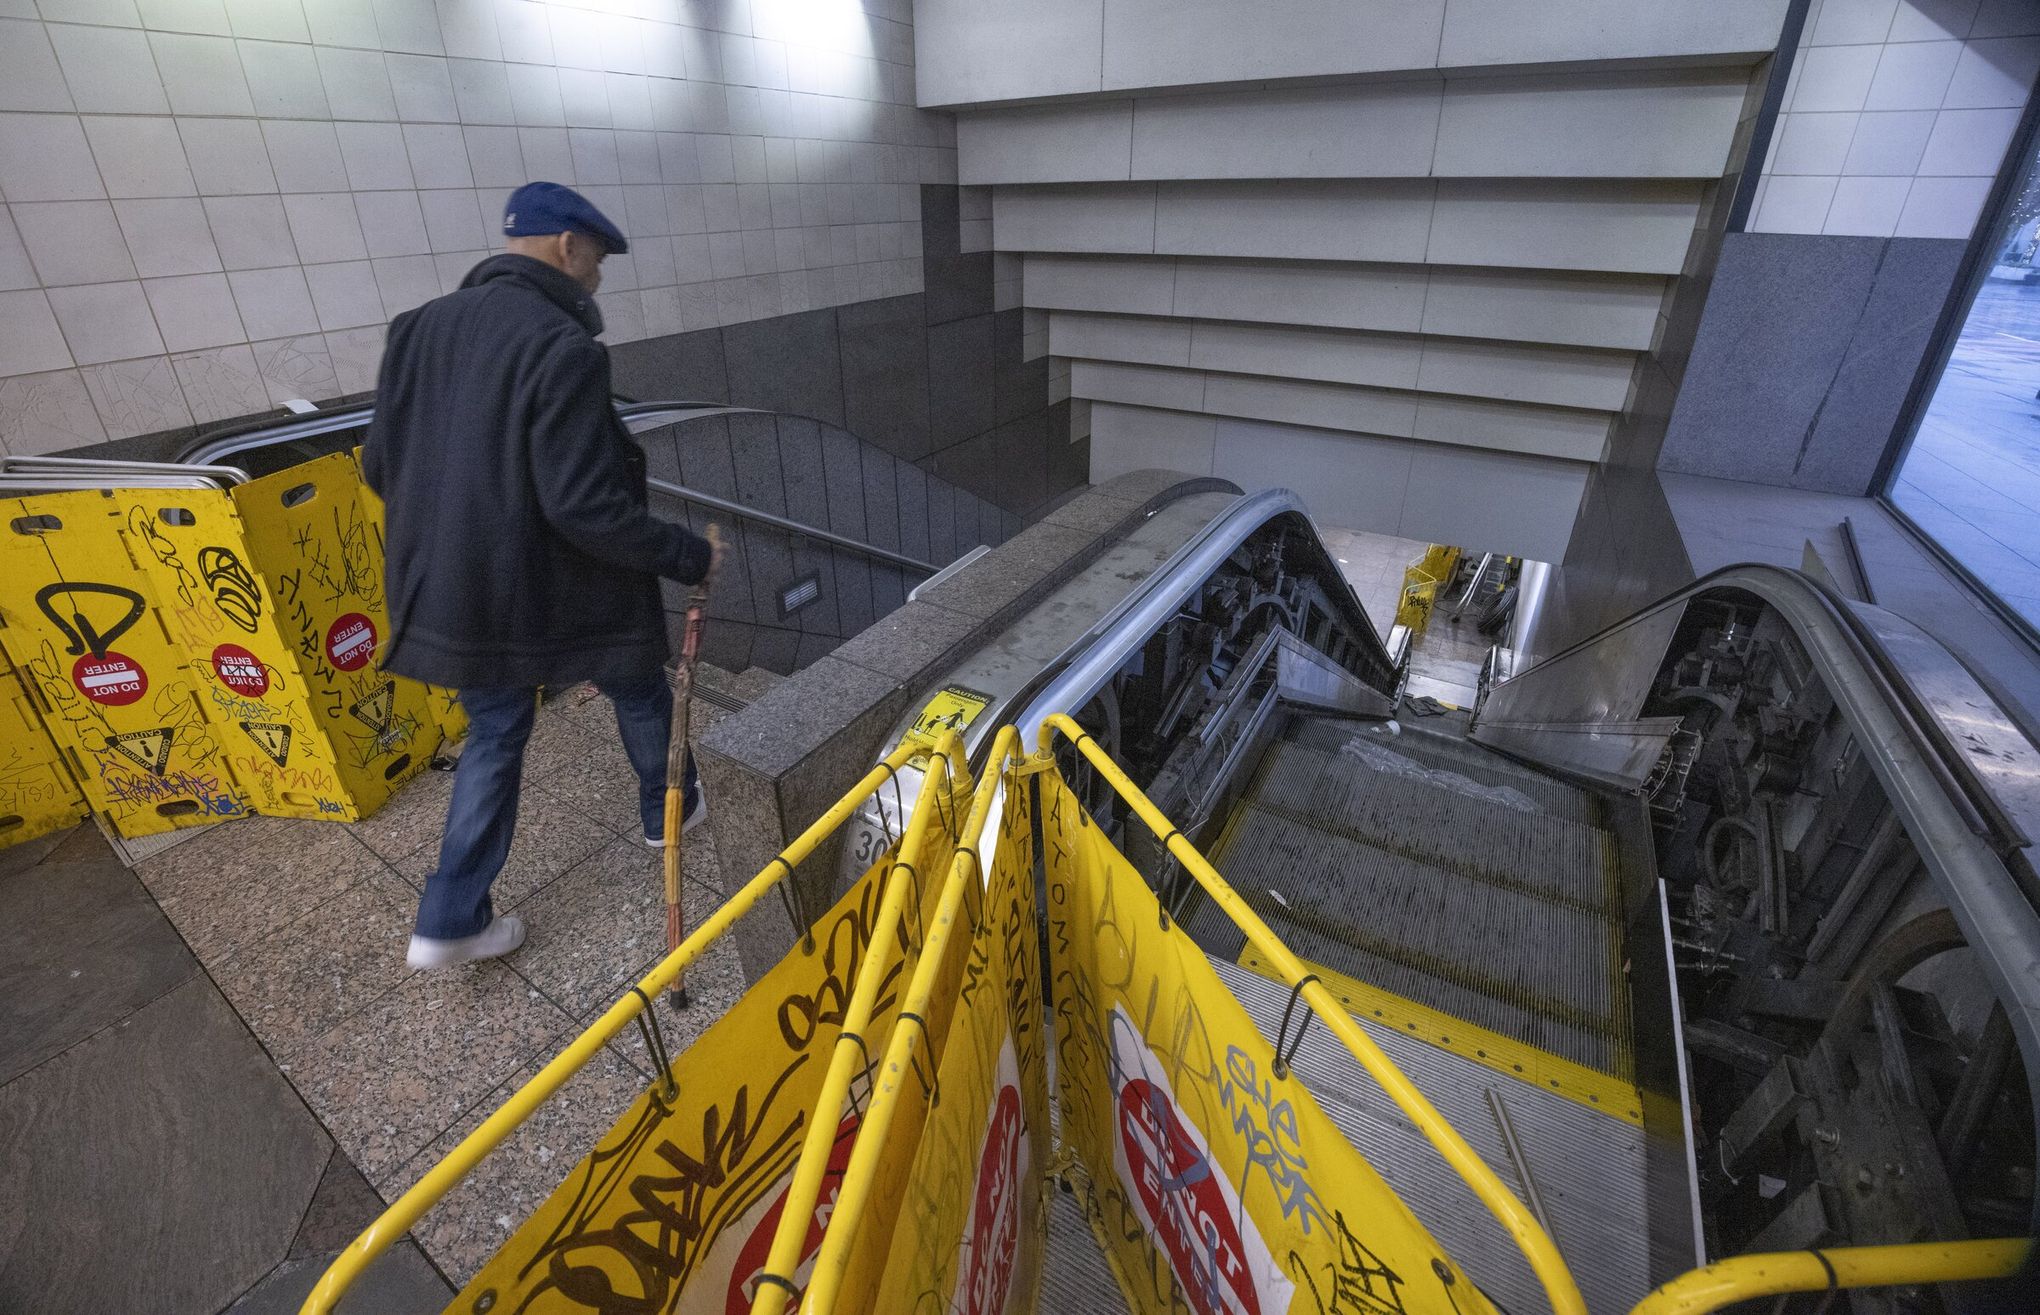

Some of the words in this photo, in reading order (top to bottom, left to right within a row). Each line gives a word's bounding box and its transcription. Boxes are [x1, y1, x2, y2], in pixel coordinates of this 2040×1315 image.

[334, 622, 363, 643] ENTER
[359, 640, 372, 653] DO
[220, 656, 252, 665] ENTER
[340, 648, 358, 665] NOT
[84, 662, 127, 675] ENTER
[93, 685, 119, 696] NOT
[120, 682, 140, 693] DO
[357, 685, 388, 708] CAUTION
[247, 722, 282, 731] CAUTION
[117, 729, 163, 742] CAUTION
[158, 738, 171, 766] CUIDADO
[247, 731, 277, 758] ATTENTION
[280, 735, 290, 757] CUIDADO
[115, 744, 152, 769] ATTENTION
[973, 1226, 989, 1311] DO
[990, 1104, 1007, 1214] NOT
